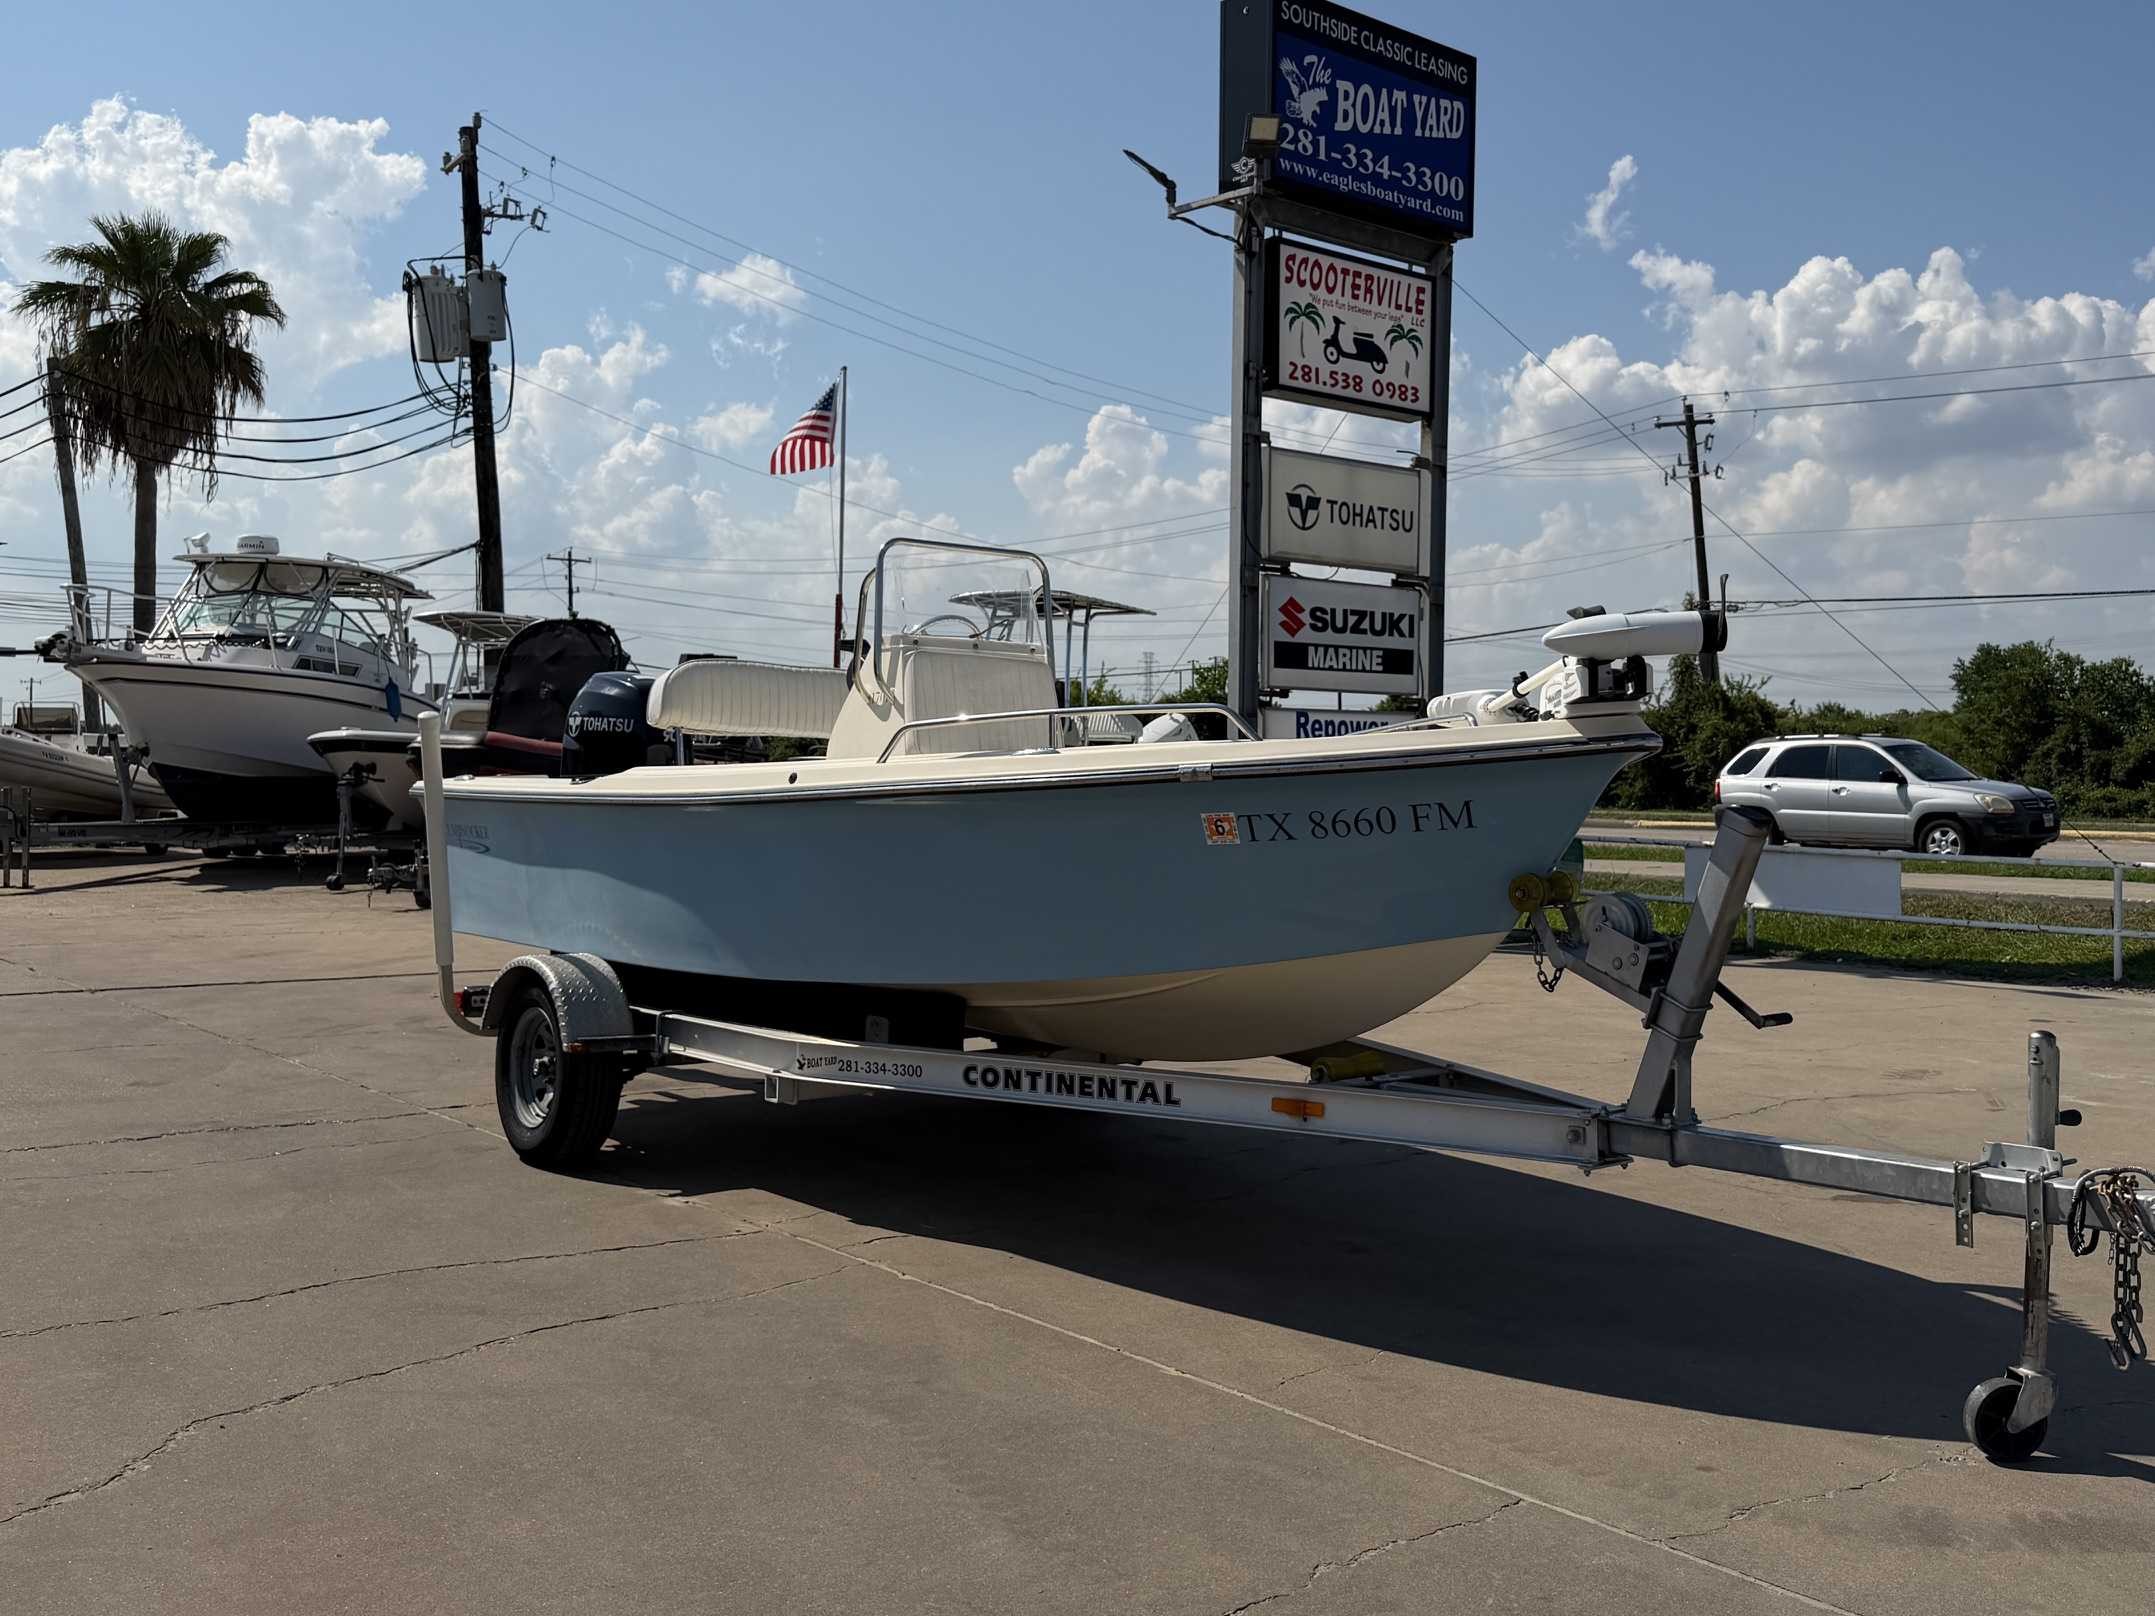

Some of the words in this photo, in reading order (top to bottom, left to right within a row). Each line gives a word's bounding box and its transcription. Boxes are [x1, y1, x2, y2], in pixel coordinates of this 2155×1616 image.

[1281, 1, 1358, 46] SOUTHSIDE
[1361, 31, 1412, 66] CLASSIC
[1415, 50, 1468, 85] LEASING
[1303, 55, 1332, 84] The
[1334, 79, 1407, 136] BOAT
[1413, 94, 1465, 139] YARD
[1280, 123, 1464, 201] 281-334-3300
[1279, 157, 1464, 222] www.eaglesboatyard.com
[1284, 253, 1426, 316] SCOOTERVILLE
[1410, 316, 1425, 328] LLC
[1372, 379, 1420, 404] 0983
[1326, 499, 1414, 533] TOHATSU
[1309, 606, 1415, 638] SUZUKI
[1307, 646, 1383, 672] MARINE
[583, 717, 634, 733] TOHATSU
[1214, 818, 1225, 836] 6
[1237, 812, 1298, 842] TX
[1308, 805, 1397, 840] 8660
[1408, 800, 1478, 833] FM
[807, 1057, 823, 1069] BOAT
[838, 1059, 923, 1078] 281-334-3300
[962, 1065, 1182, 1107] CONTINENTAL
